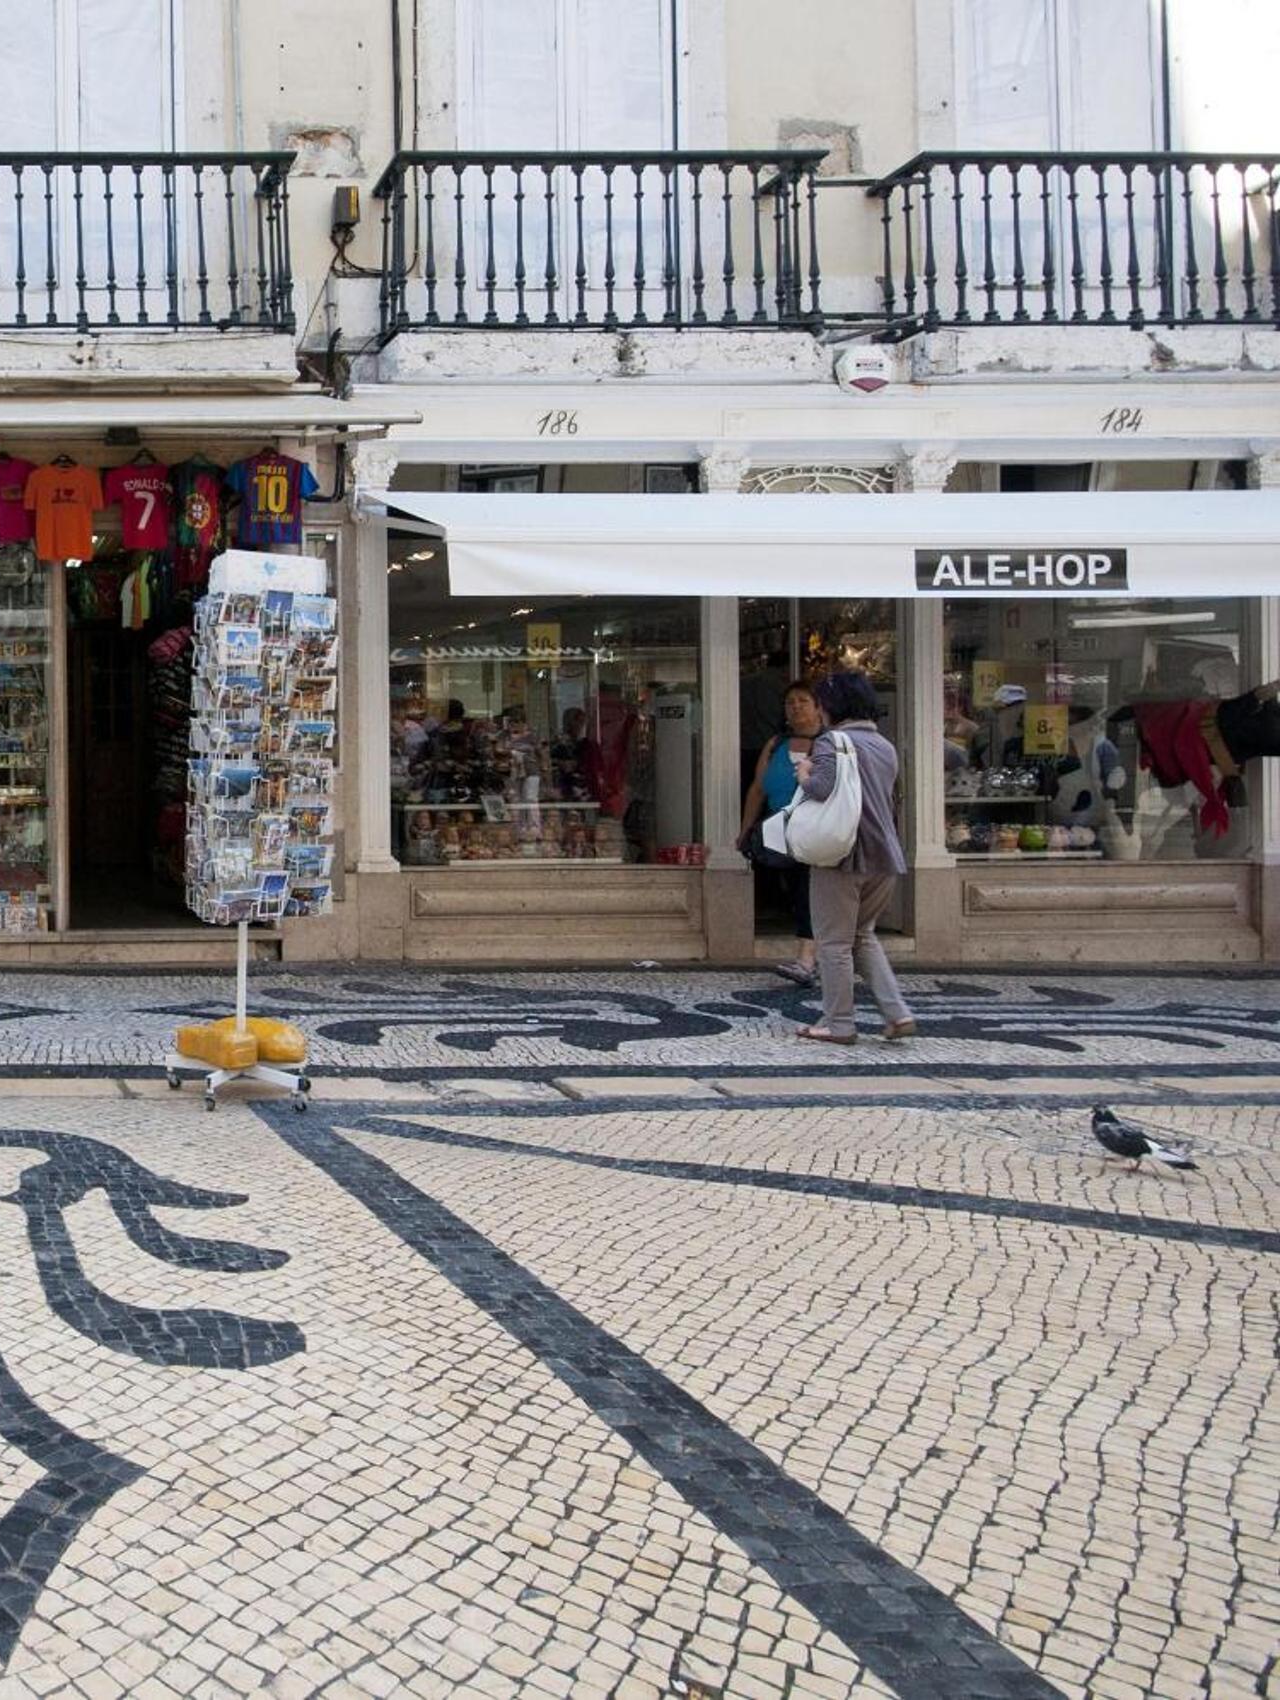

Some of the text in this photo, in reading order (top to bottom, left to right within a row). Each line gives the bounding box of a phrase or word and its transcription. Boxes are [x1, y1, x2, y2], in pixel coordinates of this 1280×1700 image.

[537, 410, 577, 435] 186
[1100, 407, 1143, 432] 184
[134, 491, 155, 530] 7
[252, 475, 288, 512] 10
[932, 553, 1113, 587] ALE-HOP
